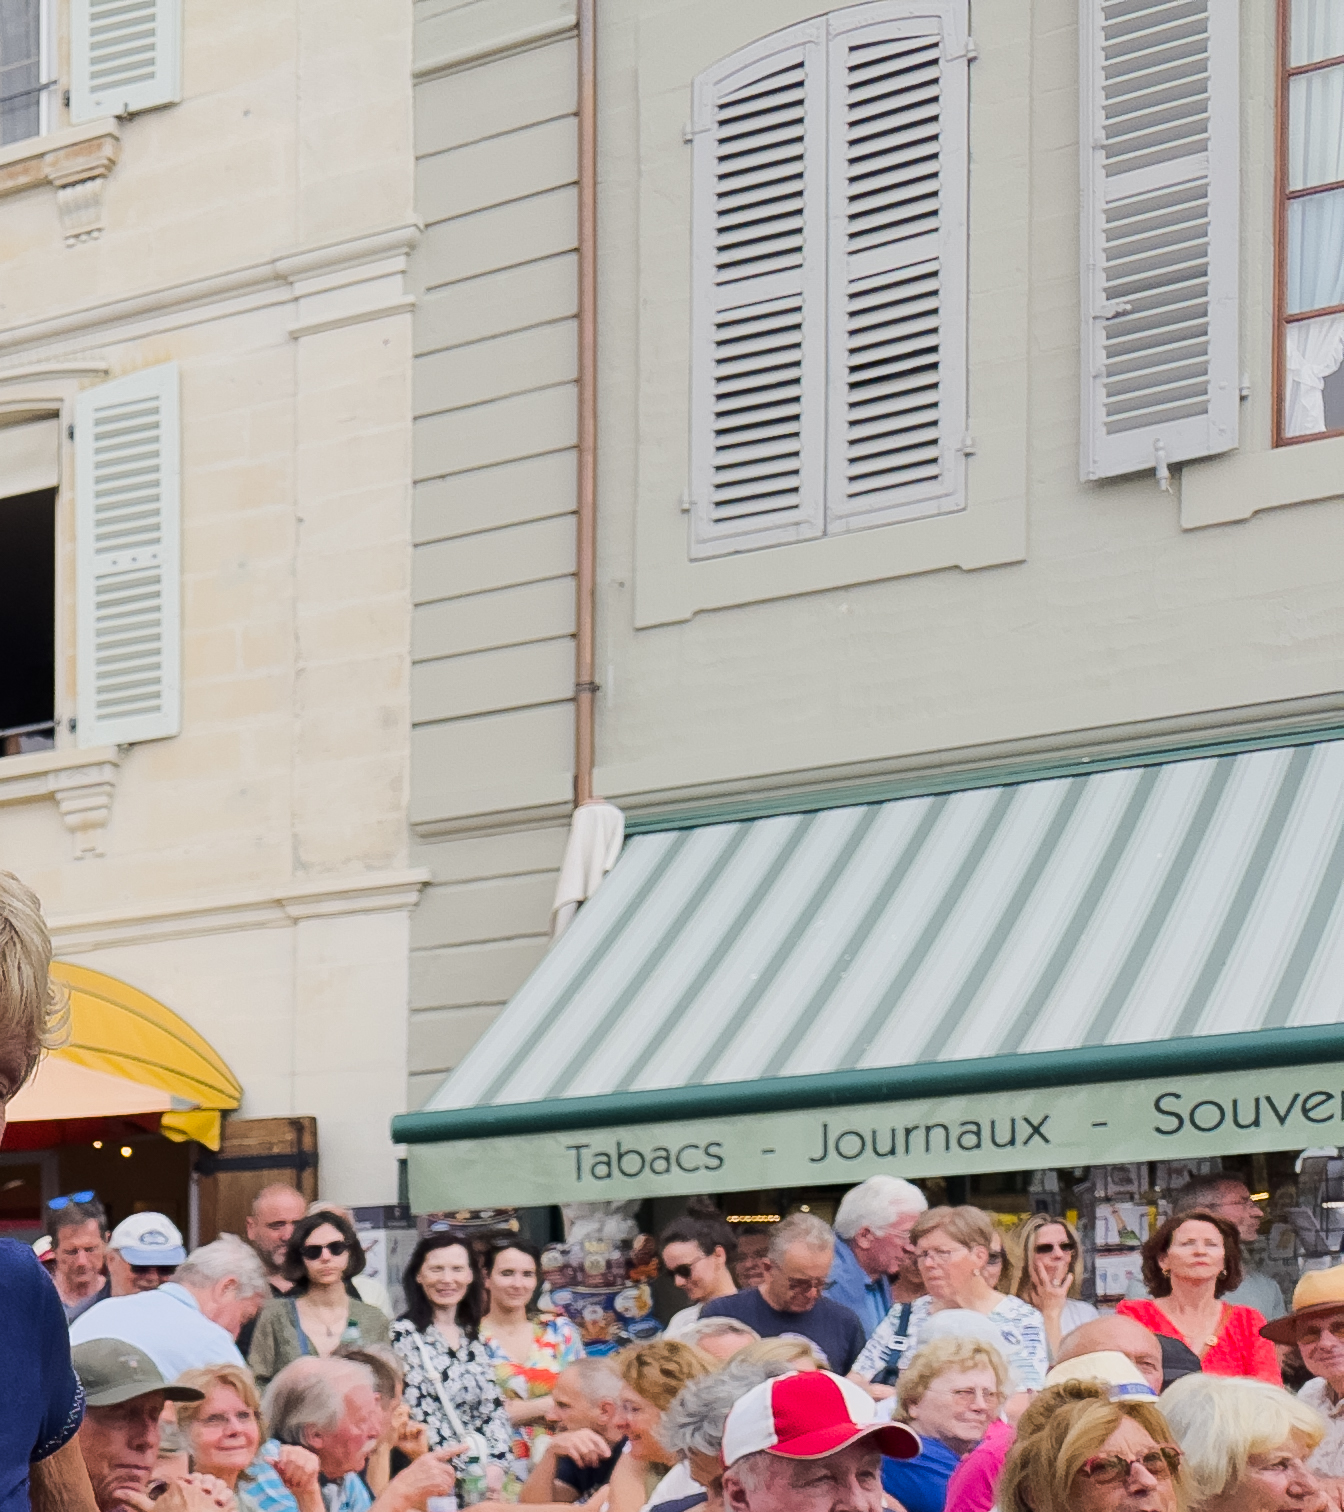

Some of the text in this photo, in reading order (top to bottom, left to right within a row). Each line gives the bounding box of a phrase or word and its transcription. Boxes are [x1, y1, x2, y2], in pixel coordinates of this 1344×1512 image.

[565, 1140, 725, 1181] Tabacs
[808, 1114, 1051, 1164] Journaux
[1153, 1089, 1344, 1136] Souve
